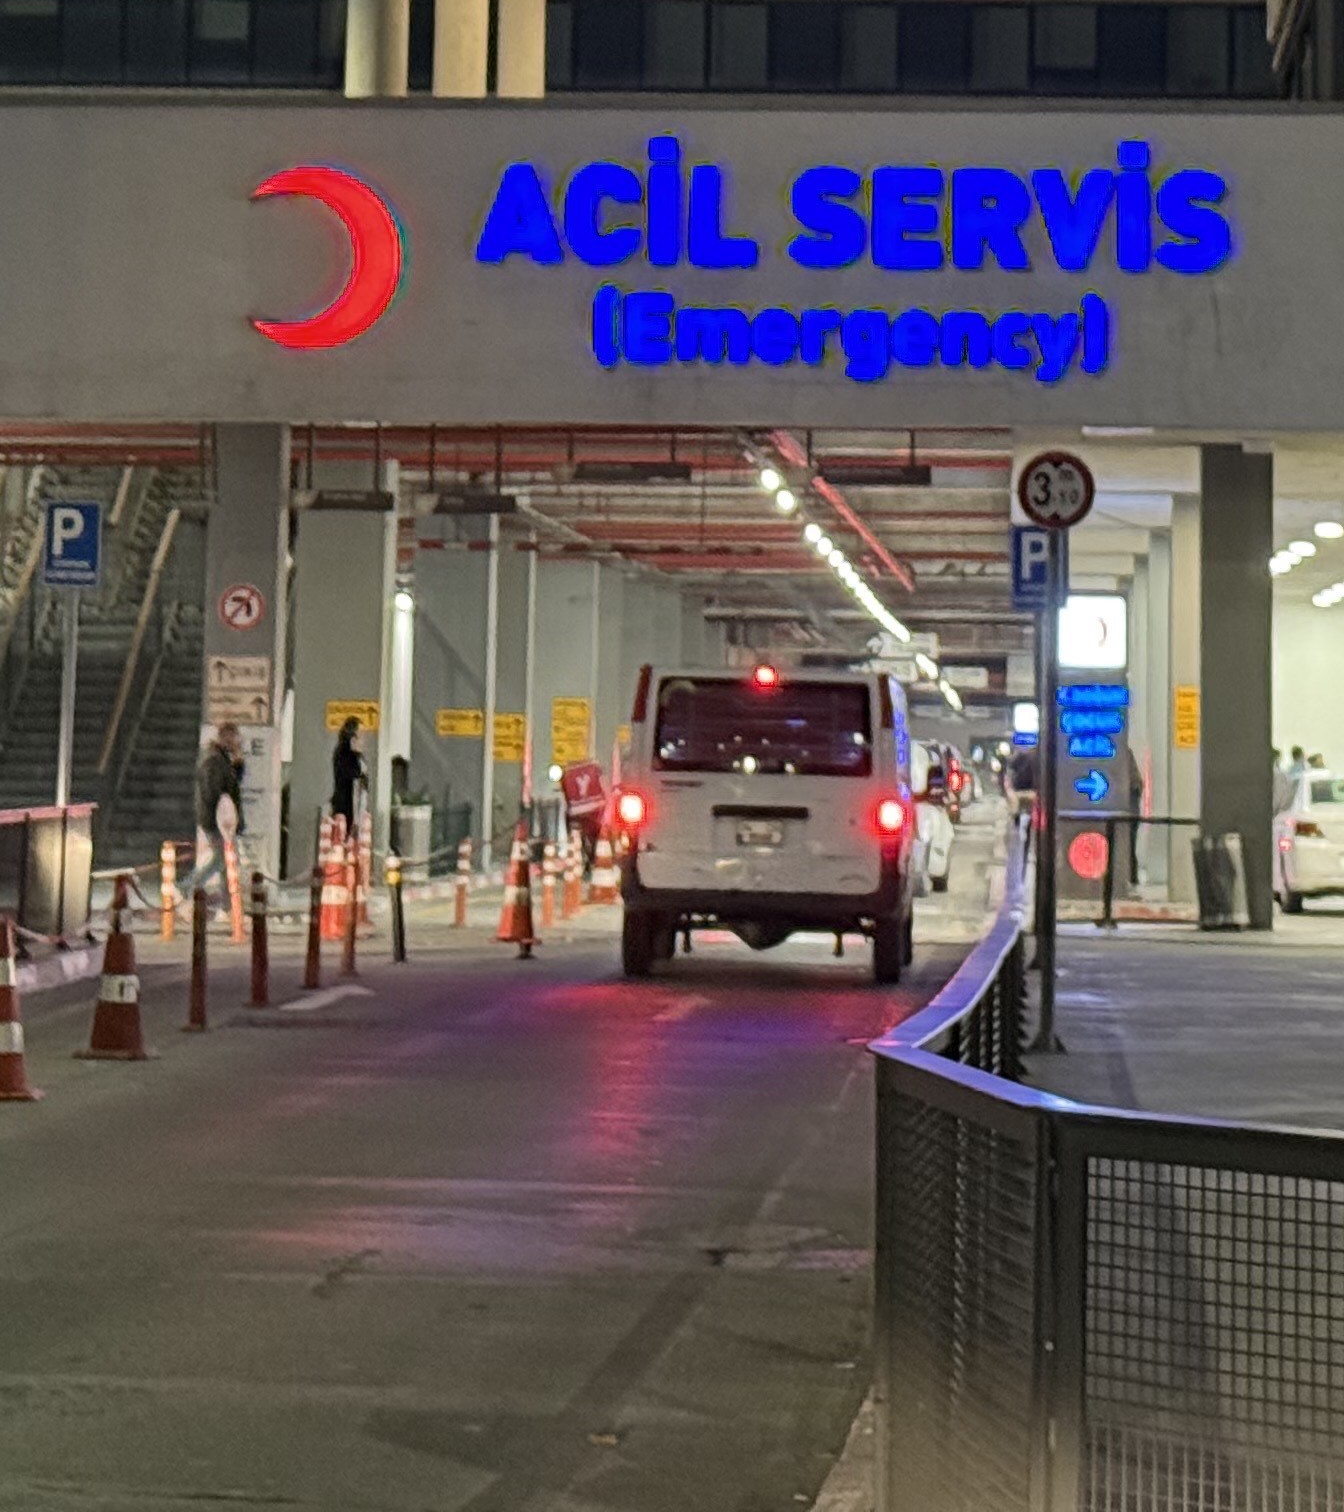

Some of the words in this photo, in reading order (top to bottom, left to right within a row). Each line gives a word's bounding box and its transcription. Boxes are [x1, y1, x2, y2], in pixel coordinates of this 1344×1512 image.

[476, 136, 758, 269] ACİL
[788, 140, 1233, 272] SERVİS
[593, 285, 1113, 383] (Emergency)
[1033, 471, 1051, 505] 3
[52, 508, 84, 555] P
[1021, 532, 1049, 579] P
